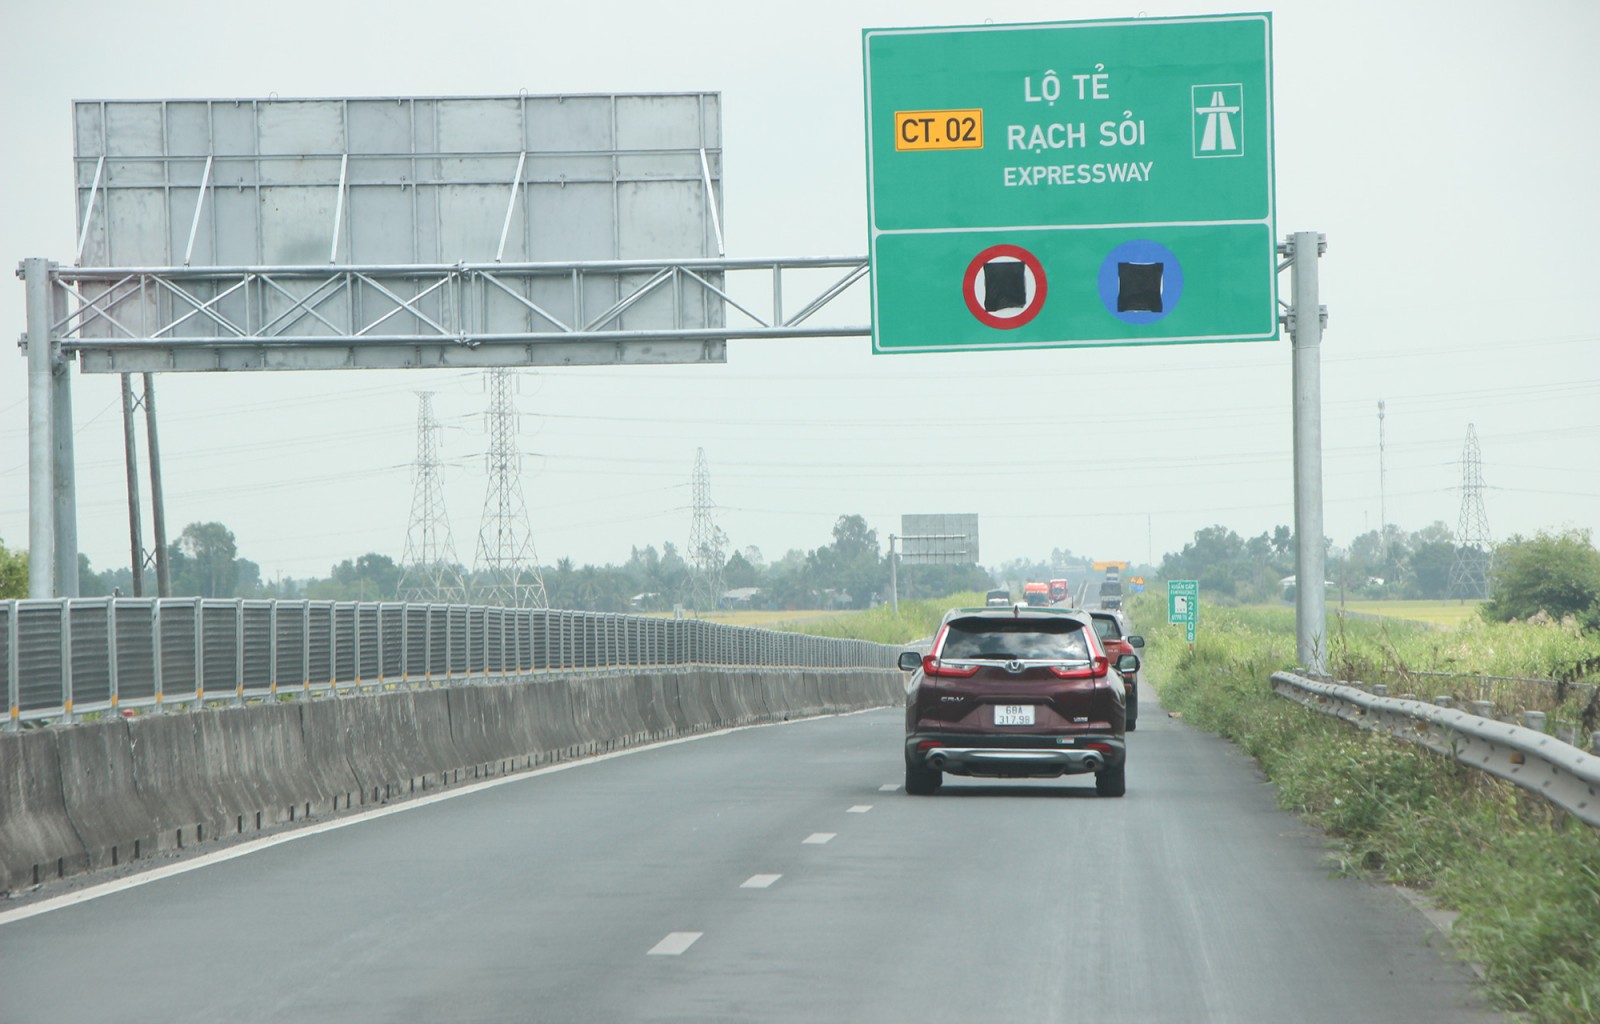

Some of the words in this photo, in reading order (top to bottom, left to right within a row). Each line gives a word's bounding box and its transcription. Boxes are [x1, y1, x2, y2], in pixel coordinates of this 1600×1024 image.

[1024, 69, 1061, 106] LỘ
[1072, 63, 1110, 100] TẺ
[1007, 122, 1086, 154] RẠCH
[1099, 110, 1145, 147] SỎI
[1003, 161, 1153, 186] EXPRESSWAY
